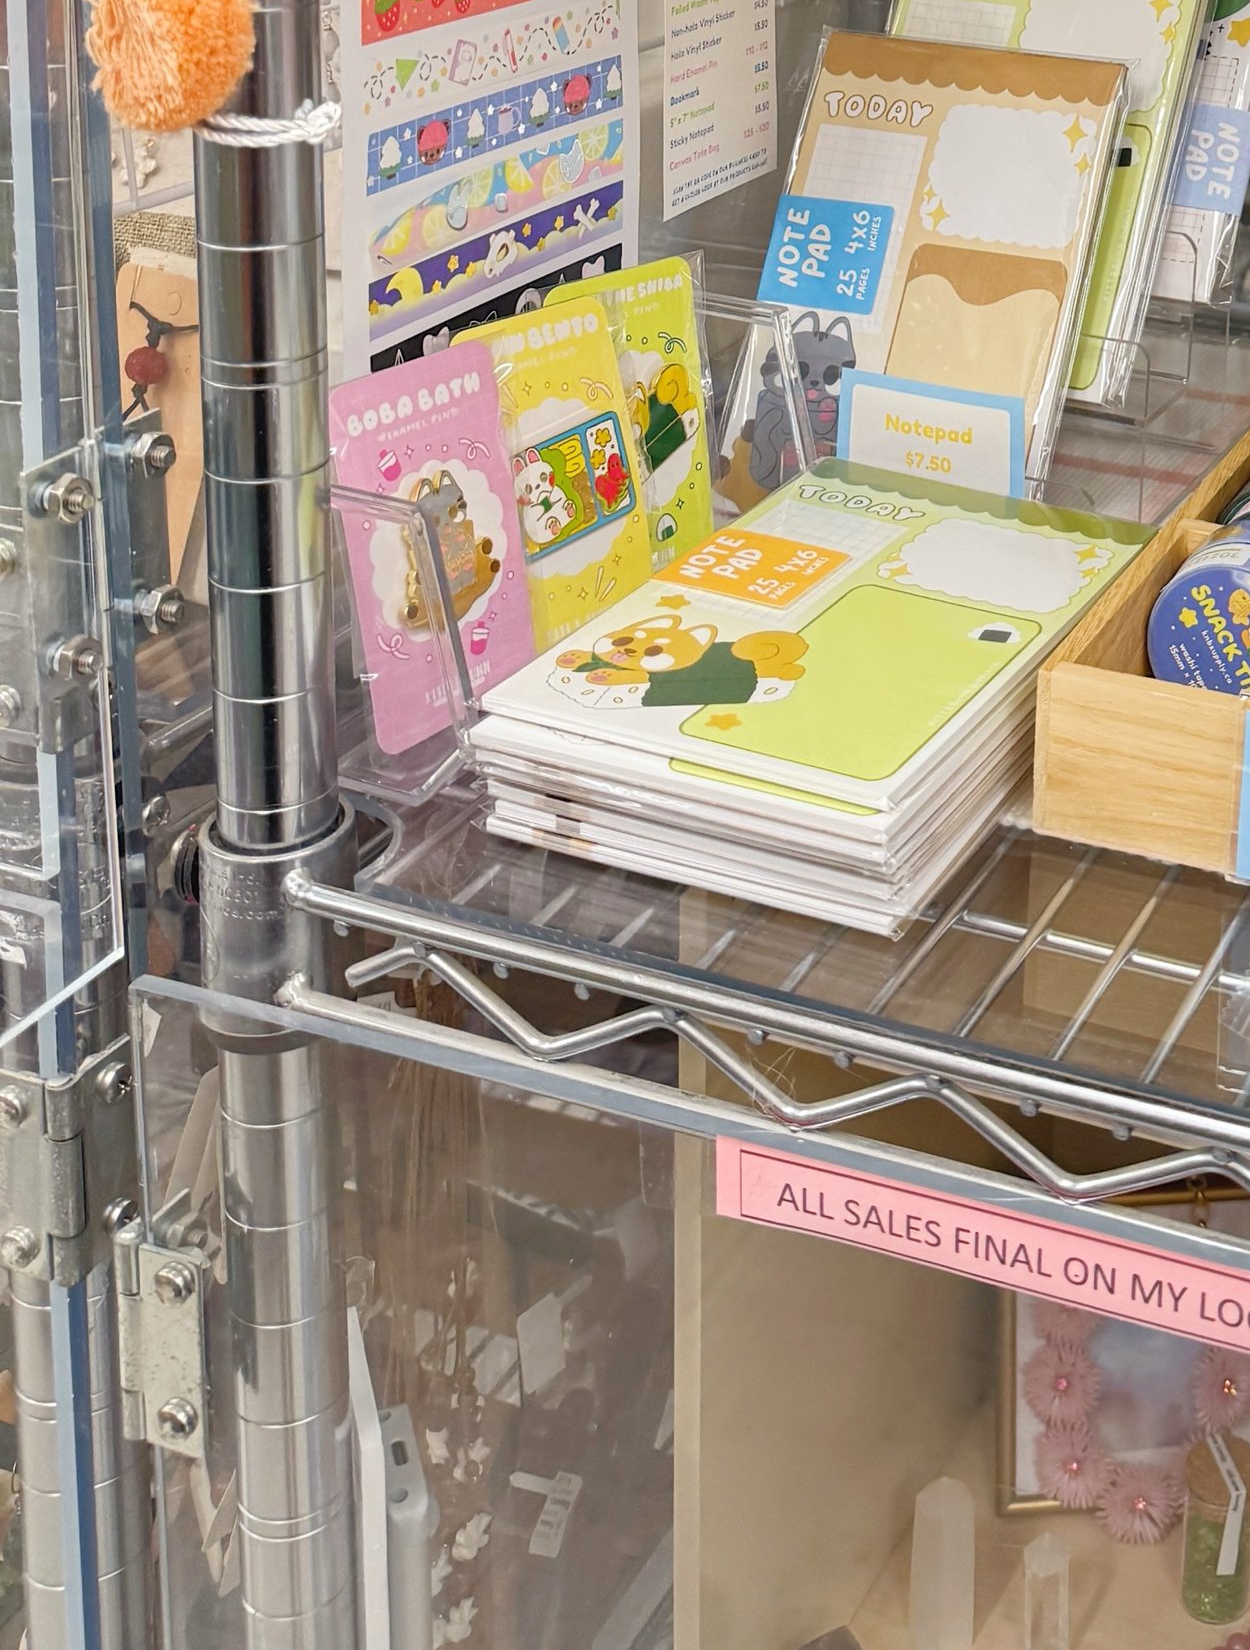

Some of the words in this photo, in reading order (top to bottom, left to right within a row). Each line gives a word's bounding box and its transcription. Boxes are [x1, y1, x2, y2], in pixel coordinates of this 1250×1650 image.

[671, 4, 690, 17] Foiled
[699, 16, 715, 29] Vinyl
[715, 9, 736, 23] Sticker
[685, 44, 702, 56] Vinyl
[701, 36, 722, 51] Sticker
[670, 87, 700, 106] Bookmark
[824, 90, 934, 127] TODAY
[670, 133, 689, 150] Sticky
[689, 124, 715, 141] Notepad
[669, 155, 692, 172] Canvas
[1184, 128, 1215, 182] PAD
[1207, 122, 1241, 199] NOTE
[777, 208, 810, 287] NOTE
[801, 224, 832, 278] PAD
[855, 268, 871, 300] PAGES
[867, 216, 882, 251] INCHES
[836, 269, 857, 297] 25
[527, 312, 600, 349] BENTO
[345, 391, 413, 438] BOBA
[417, 371, 481, 411] BATH
[885, 413, 973, 445] Notepad
[905, 451, 952, 473] $7.50
[799, 483, 926, 521] TODAY
[679, 535, 746, 579] NOTE
[711, 548, 764, 580] PAD
[748, 576, 779, 595] 25
[1190, 584, 1243, 663] SNACK
[1168, 644, 1186, 671] 15mm
[1178, 642, 1197, 671] washi
[1200, 629, 1233, 685] knbsupply.co
[777, 1182, 835, 1222] ALL
[843, 1199, 942, 1247] SALES
[954, 1226, 1053, 1278] FINAL
[1063, 1256, 1117, 1295] ON
[1130, 1273, 1188, 1313] MY
